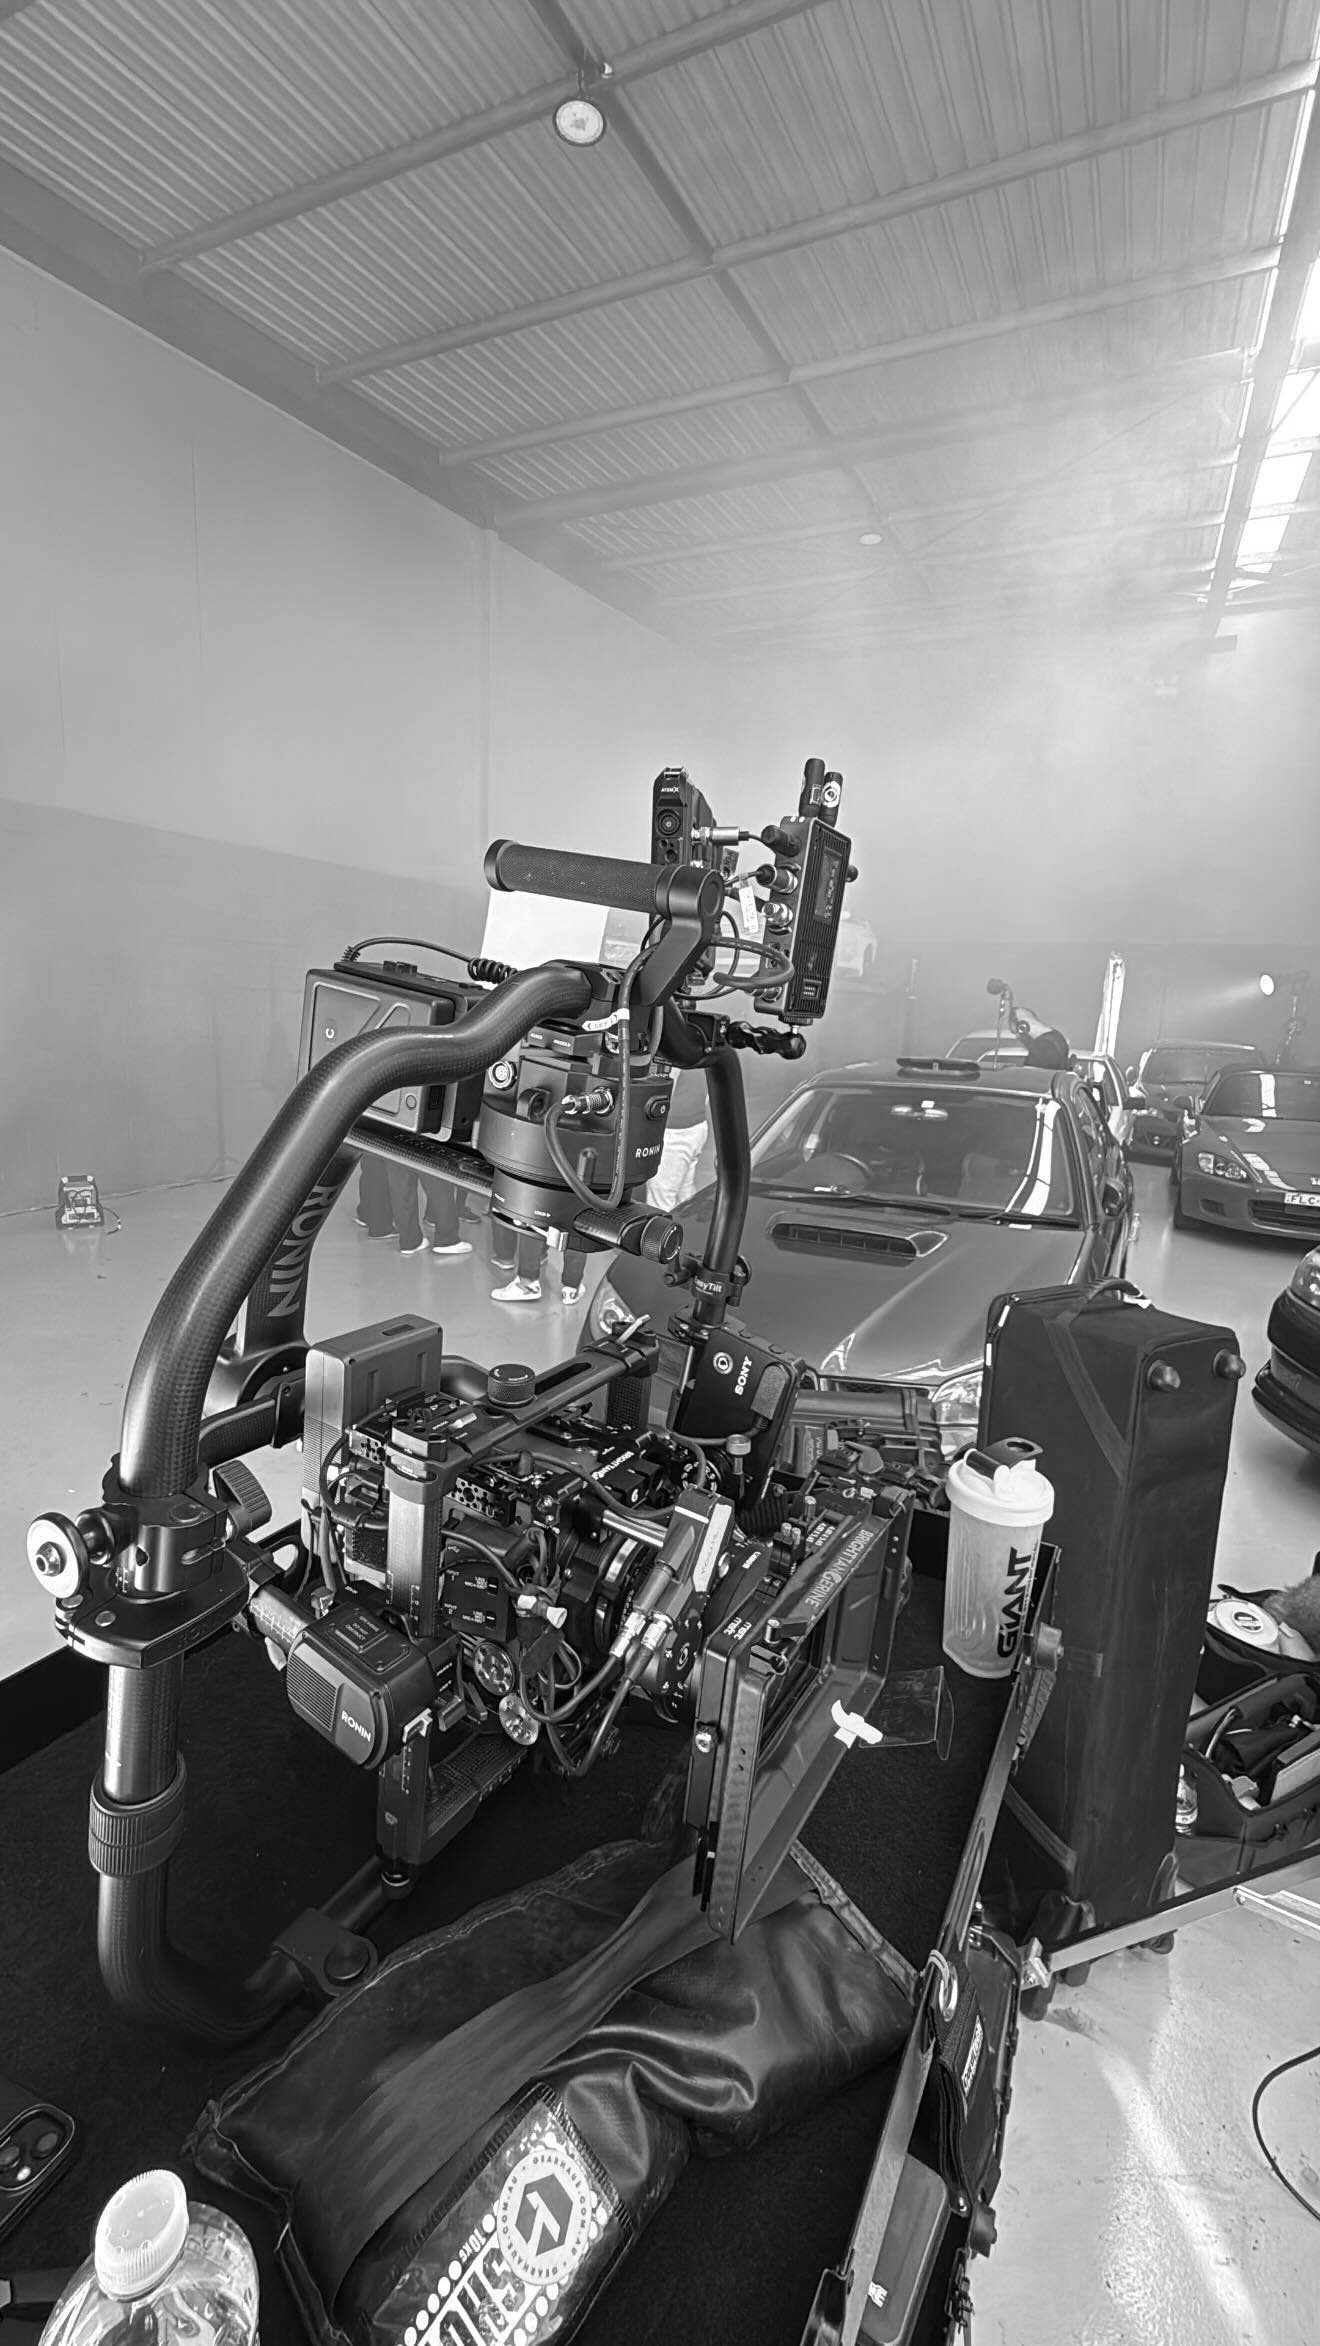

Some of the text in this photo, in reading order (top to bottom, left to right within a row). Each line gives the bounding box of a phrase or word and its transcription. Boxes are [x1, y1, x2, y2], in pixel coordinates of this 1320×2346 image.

[635, 1144, 660, 1158] RONIN
[267, 1185, 339, 1317] RONIN
[735, 1355, 752, 1395] SONY
[997, 1546, 1032, 1658] GIANT
[341, 1710, 371, 1742] RONIN
